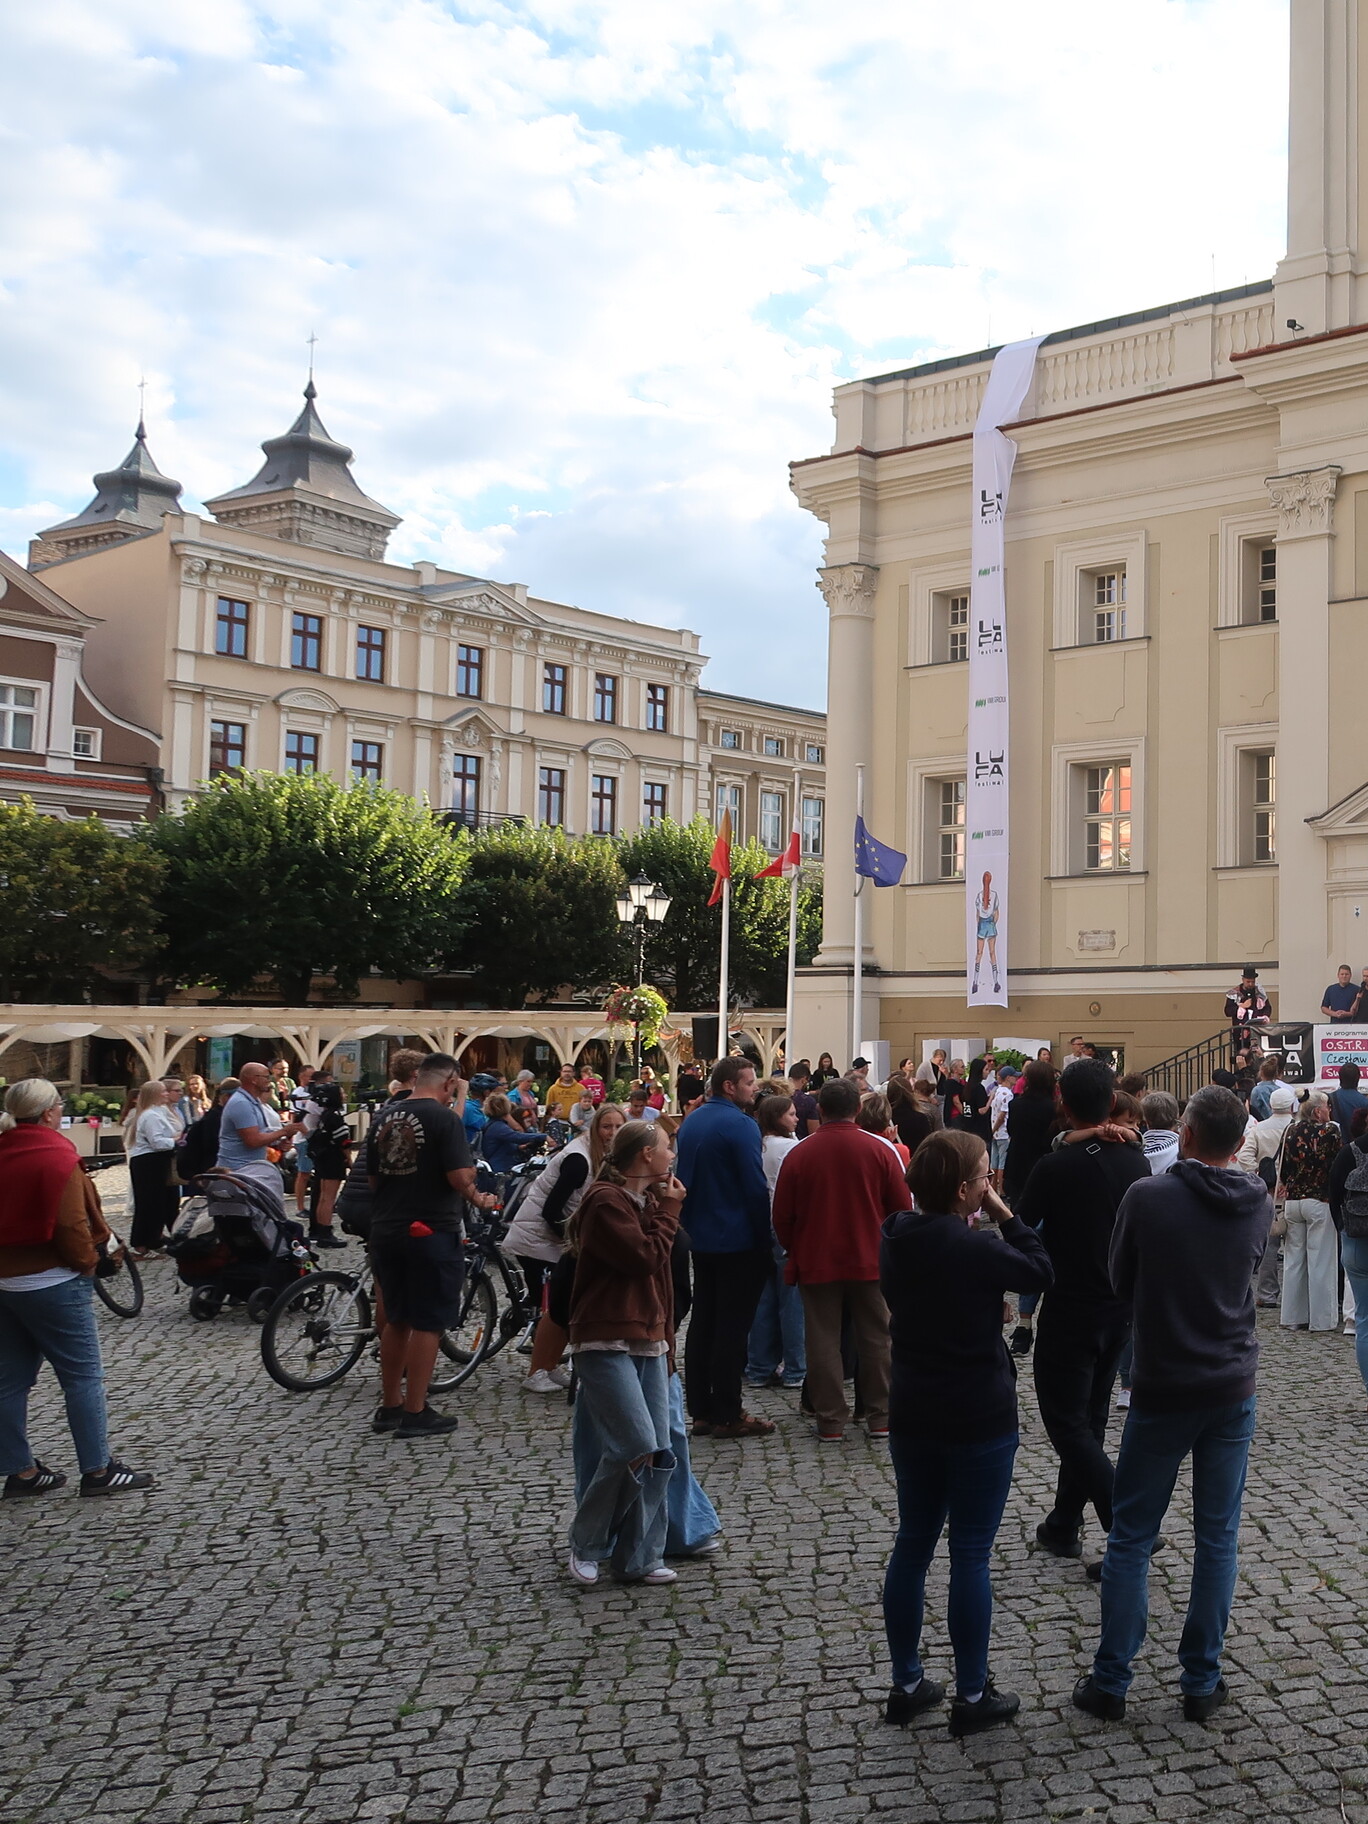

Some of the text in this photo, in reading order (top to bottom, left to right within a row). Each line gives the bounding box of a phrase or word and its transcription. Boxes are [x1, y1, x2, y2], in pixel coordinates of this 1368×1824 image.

[1261, 1035, 1303, 1050] LU
[1326, 1040, 1366, 1050] O.S.T.R.
[1326, 1053, 1368, 1064] Czesław
